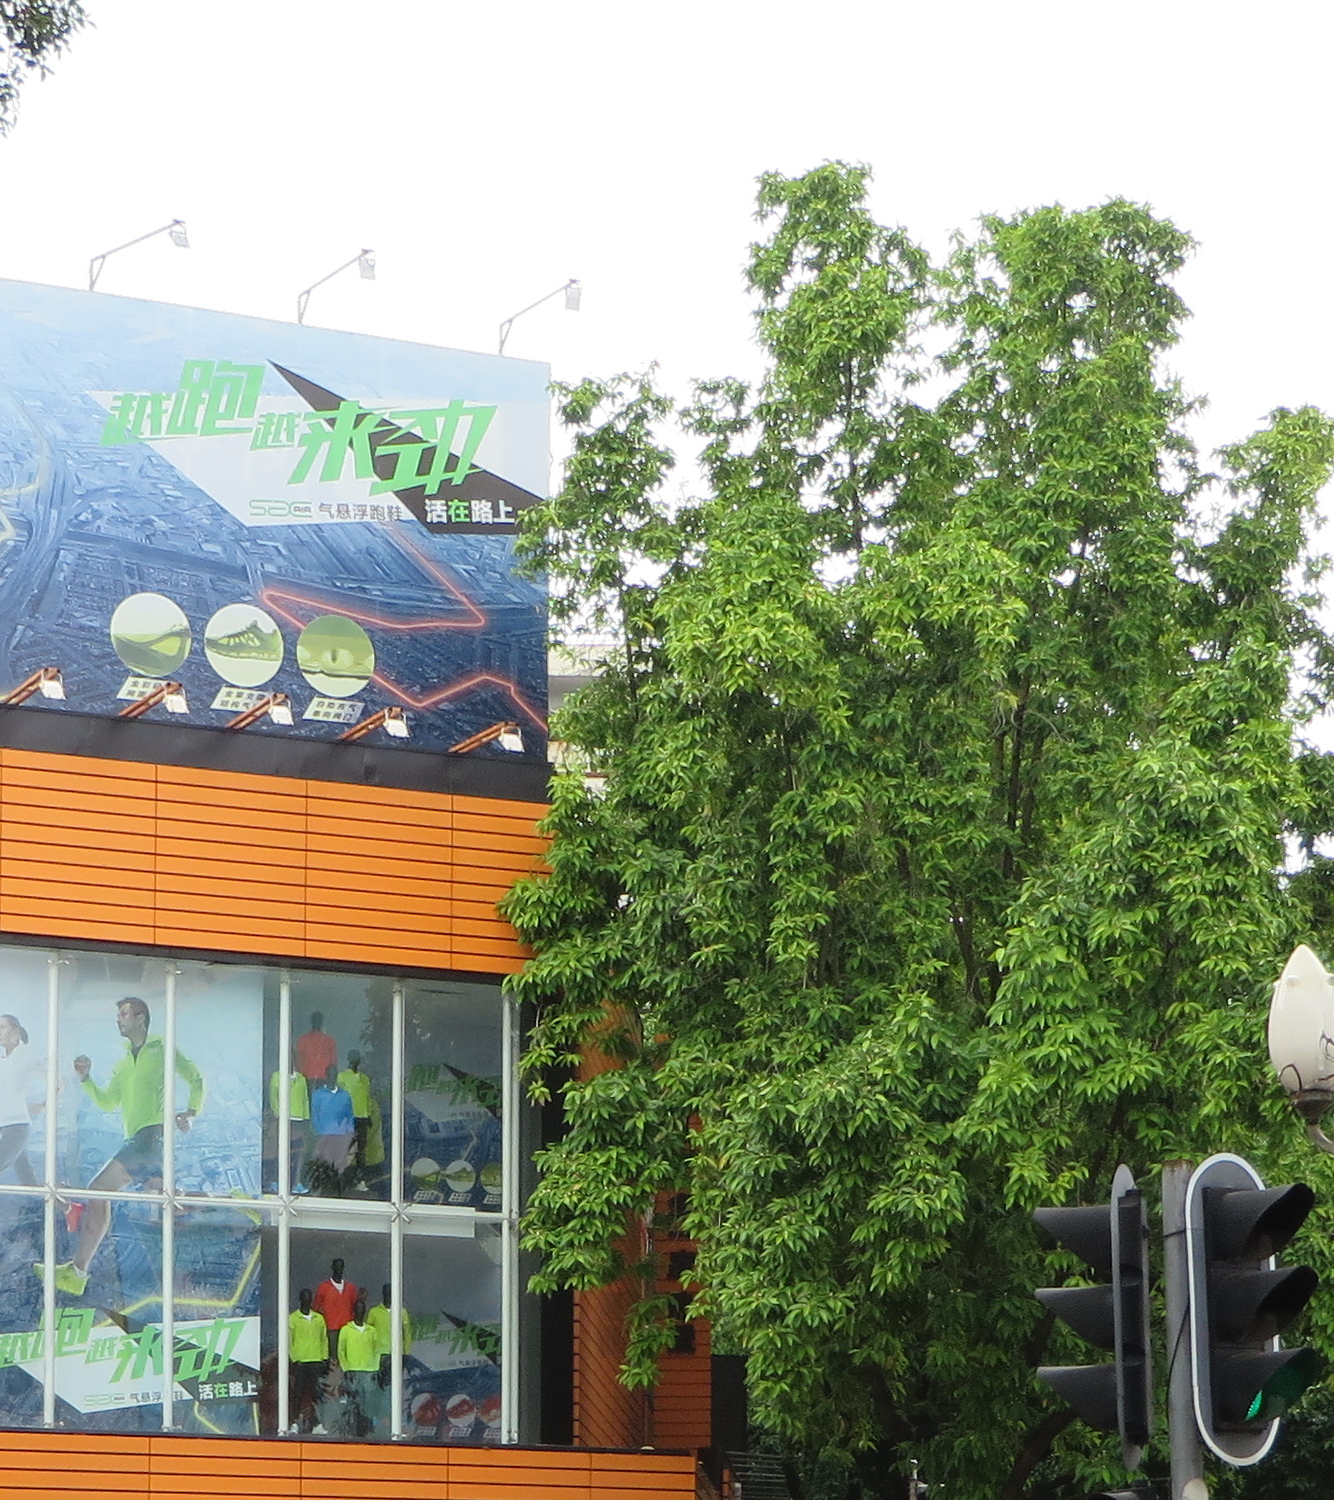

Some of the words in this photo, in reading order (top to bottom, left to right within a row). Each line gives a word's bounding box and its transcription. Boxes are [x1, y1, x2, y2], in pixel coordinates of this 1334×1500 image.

[318, 501, 404, 522] 气悬浮跑鞋
[423, 498, 517, 525] 活在路上
[198, 1380, 258, 1401] 活在路上
